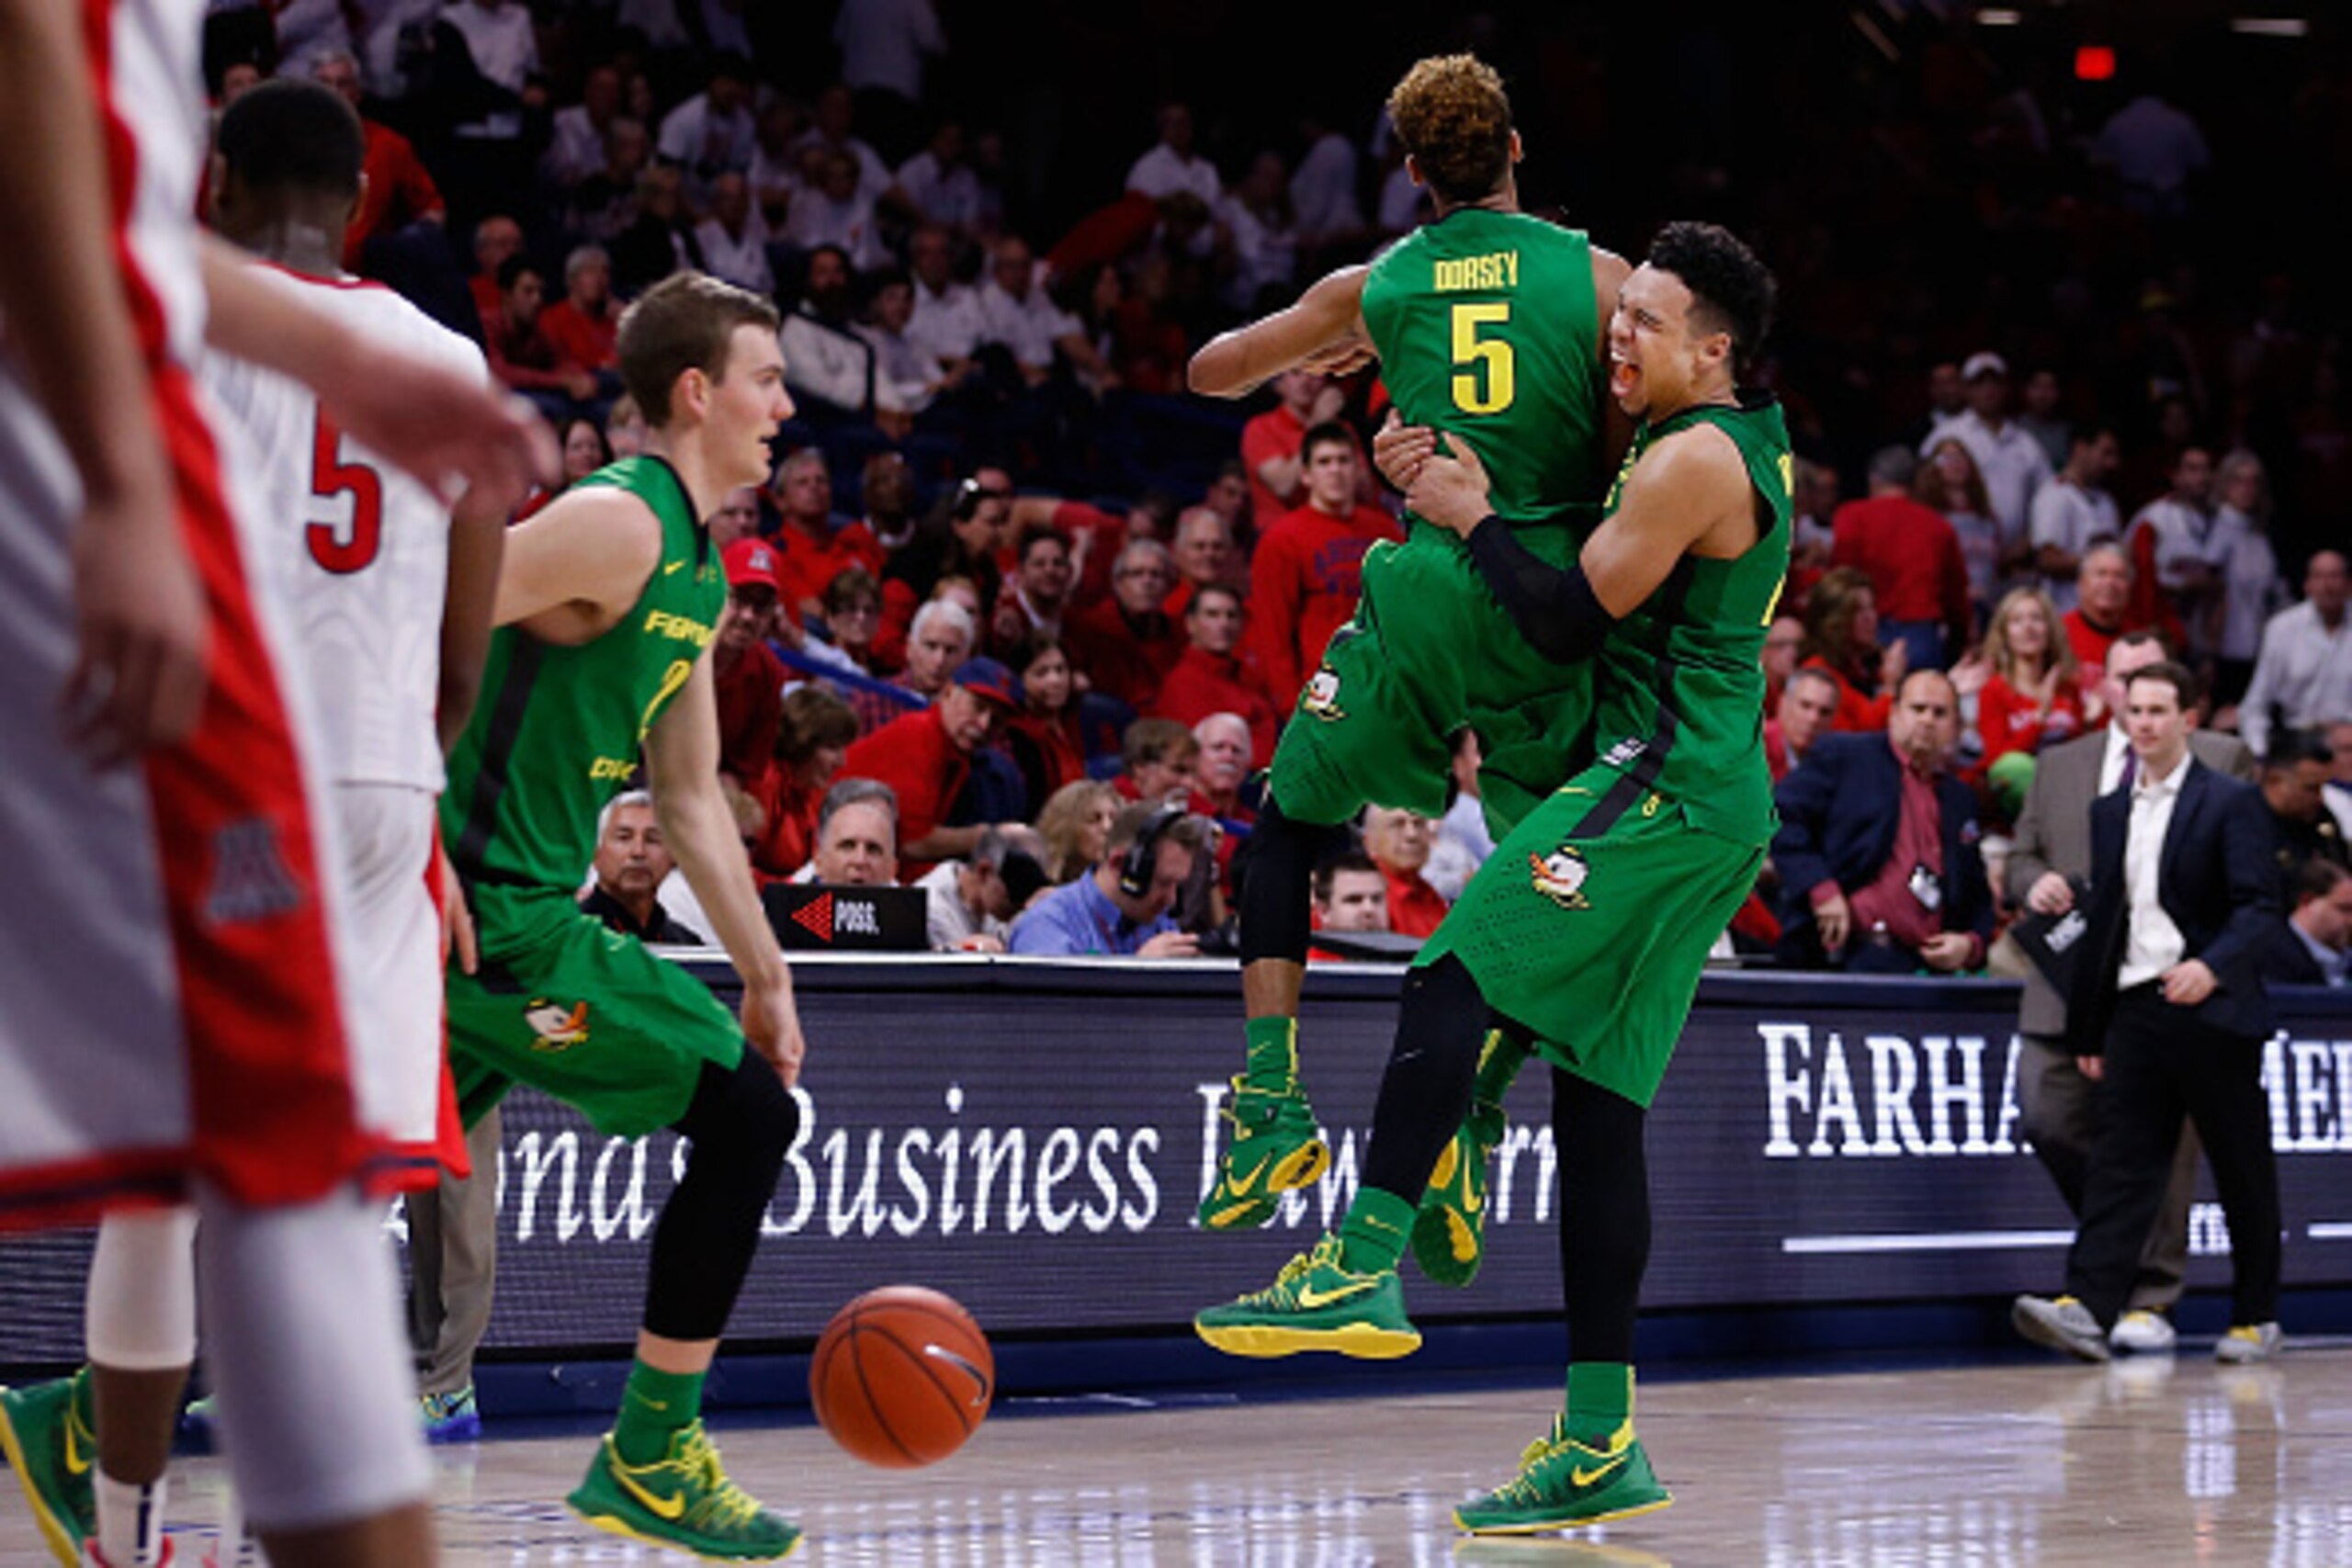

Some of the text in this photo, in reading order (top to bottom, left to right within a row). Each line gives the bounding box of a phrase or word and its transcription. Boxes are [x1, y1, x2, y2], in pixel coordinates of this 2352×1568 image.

[1434, 250, 1519, 291] DORSEY
[1452, 302, 1514, 414] 5
[304, 400, 382, 575] 5
[834, 899, 880, 935] POSS.
[760, 1082, 1160, 1237] Business
